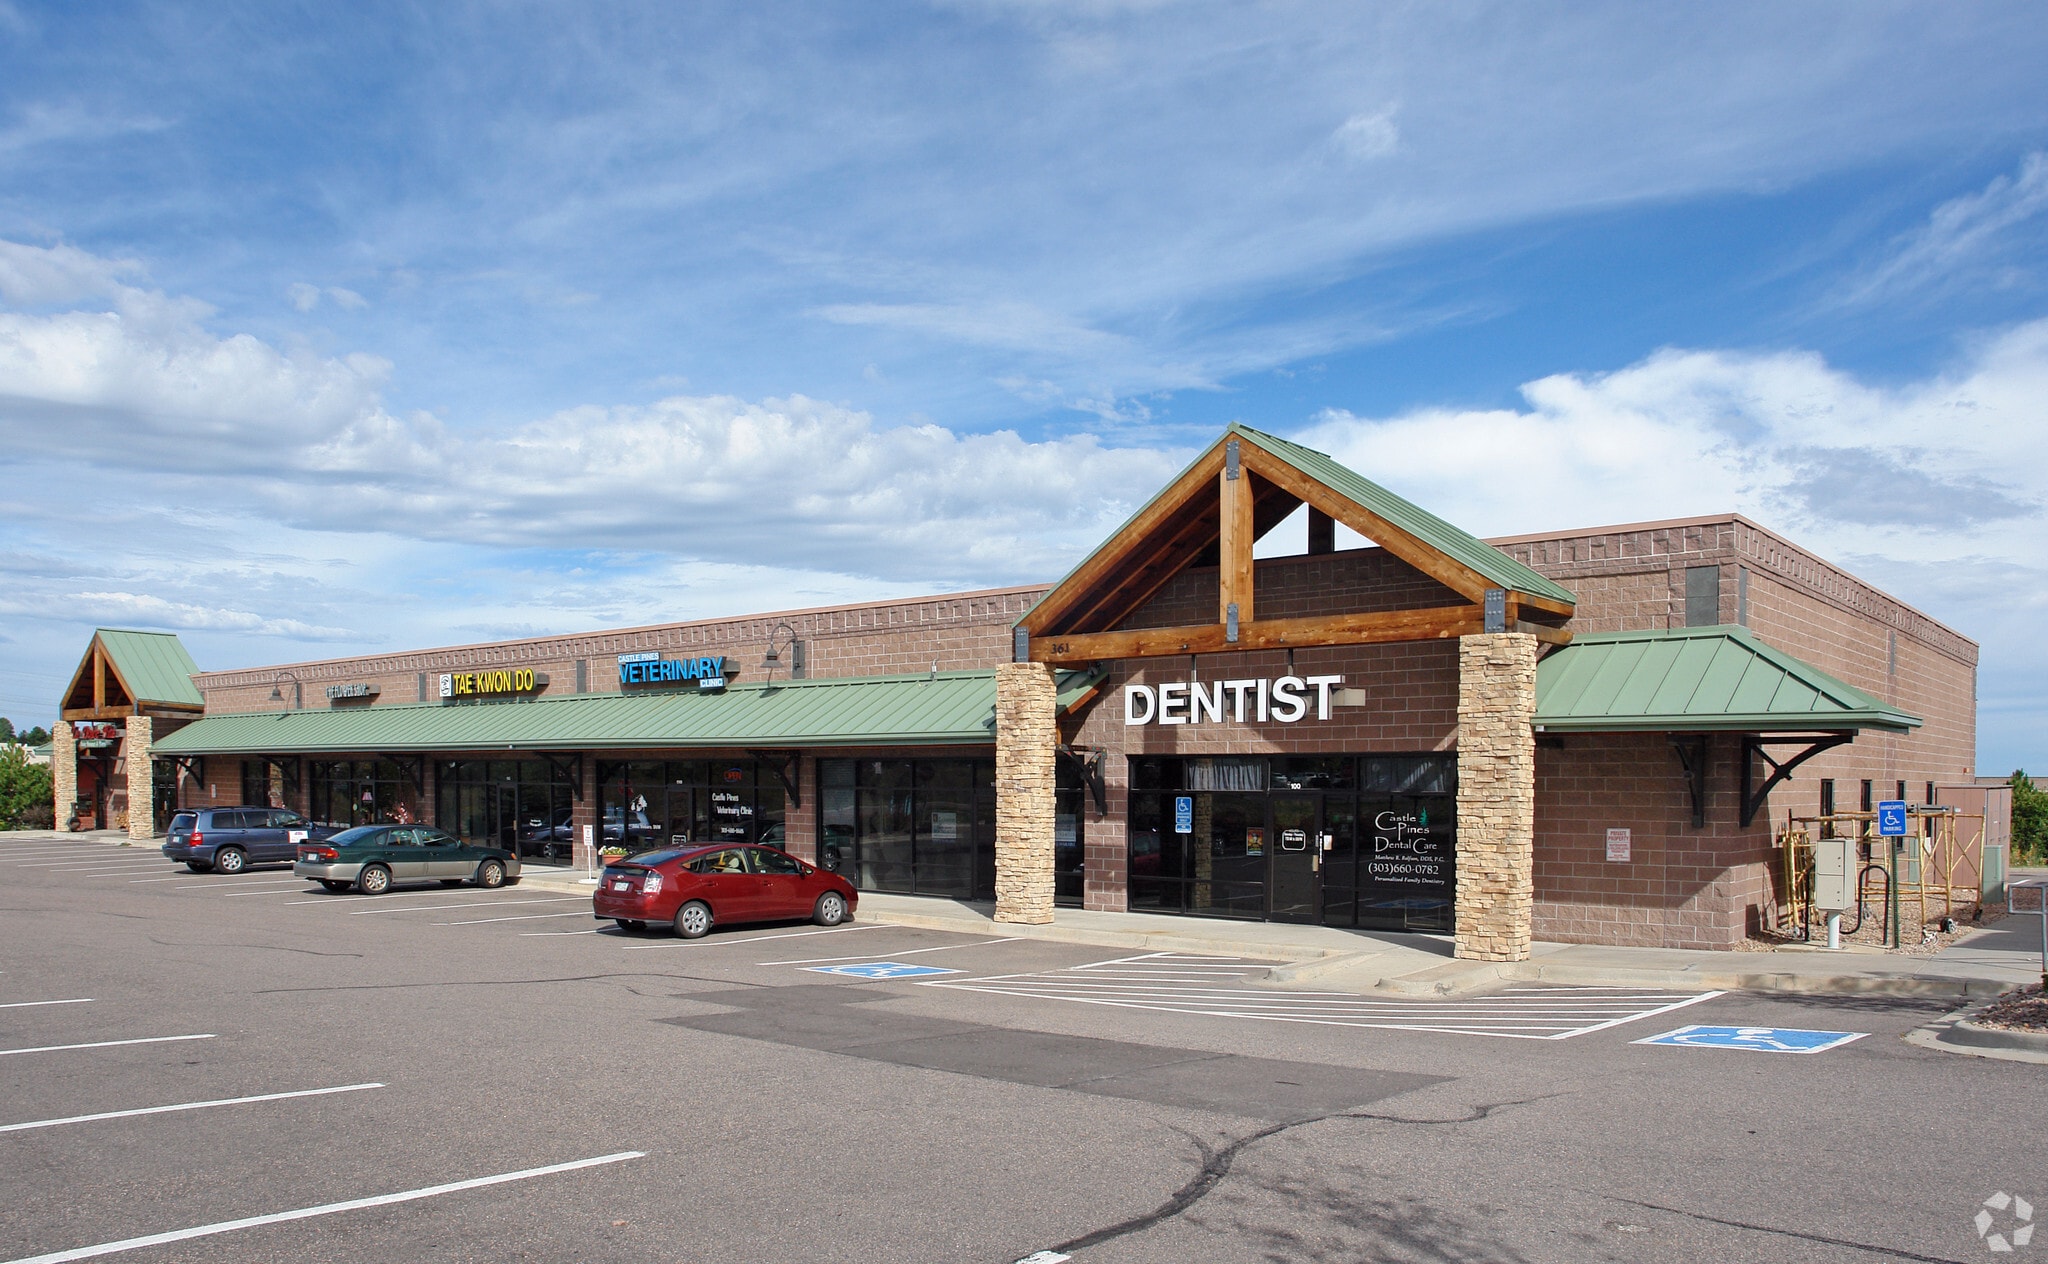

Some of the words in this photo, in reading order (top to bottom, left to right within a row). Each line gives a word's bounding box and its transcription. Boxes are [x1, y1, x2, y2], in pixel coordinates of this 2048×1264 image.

[618, 654, 640, 662] CASTLE
[641, 652, 659, 661] PINES
[1051, 643, 1070, 655] 361
[618, 656, 724, 683] VETERINARY
[453, 673, 473, 694] TAE
[477, 671, 512, 693] KWON
[515, 668, 534, 691] DO
[701, 679, 723, 688] CLINIC
[1125, 675, 1343, 726] DENTIST
[1375, 811, 1417, 831] Castle
[1398, 822, 1430, 841] Pines
[1375, 836, 1411, 852] Dental
[1413, 838, 1438, 854] Care
[1368, 862, 1439, 875] (303)660-0782
